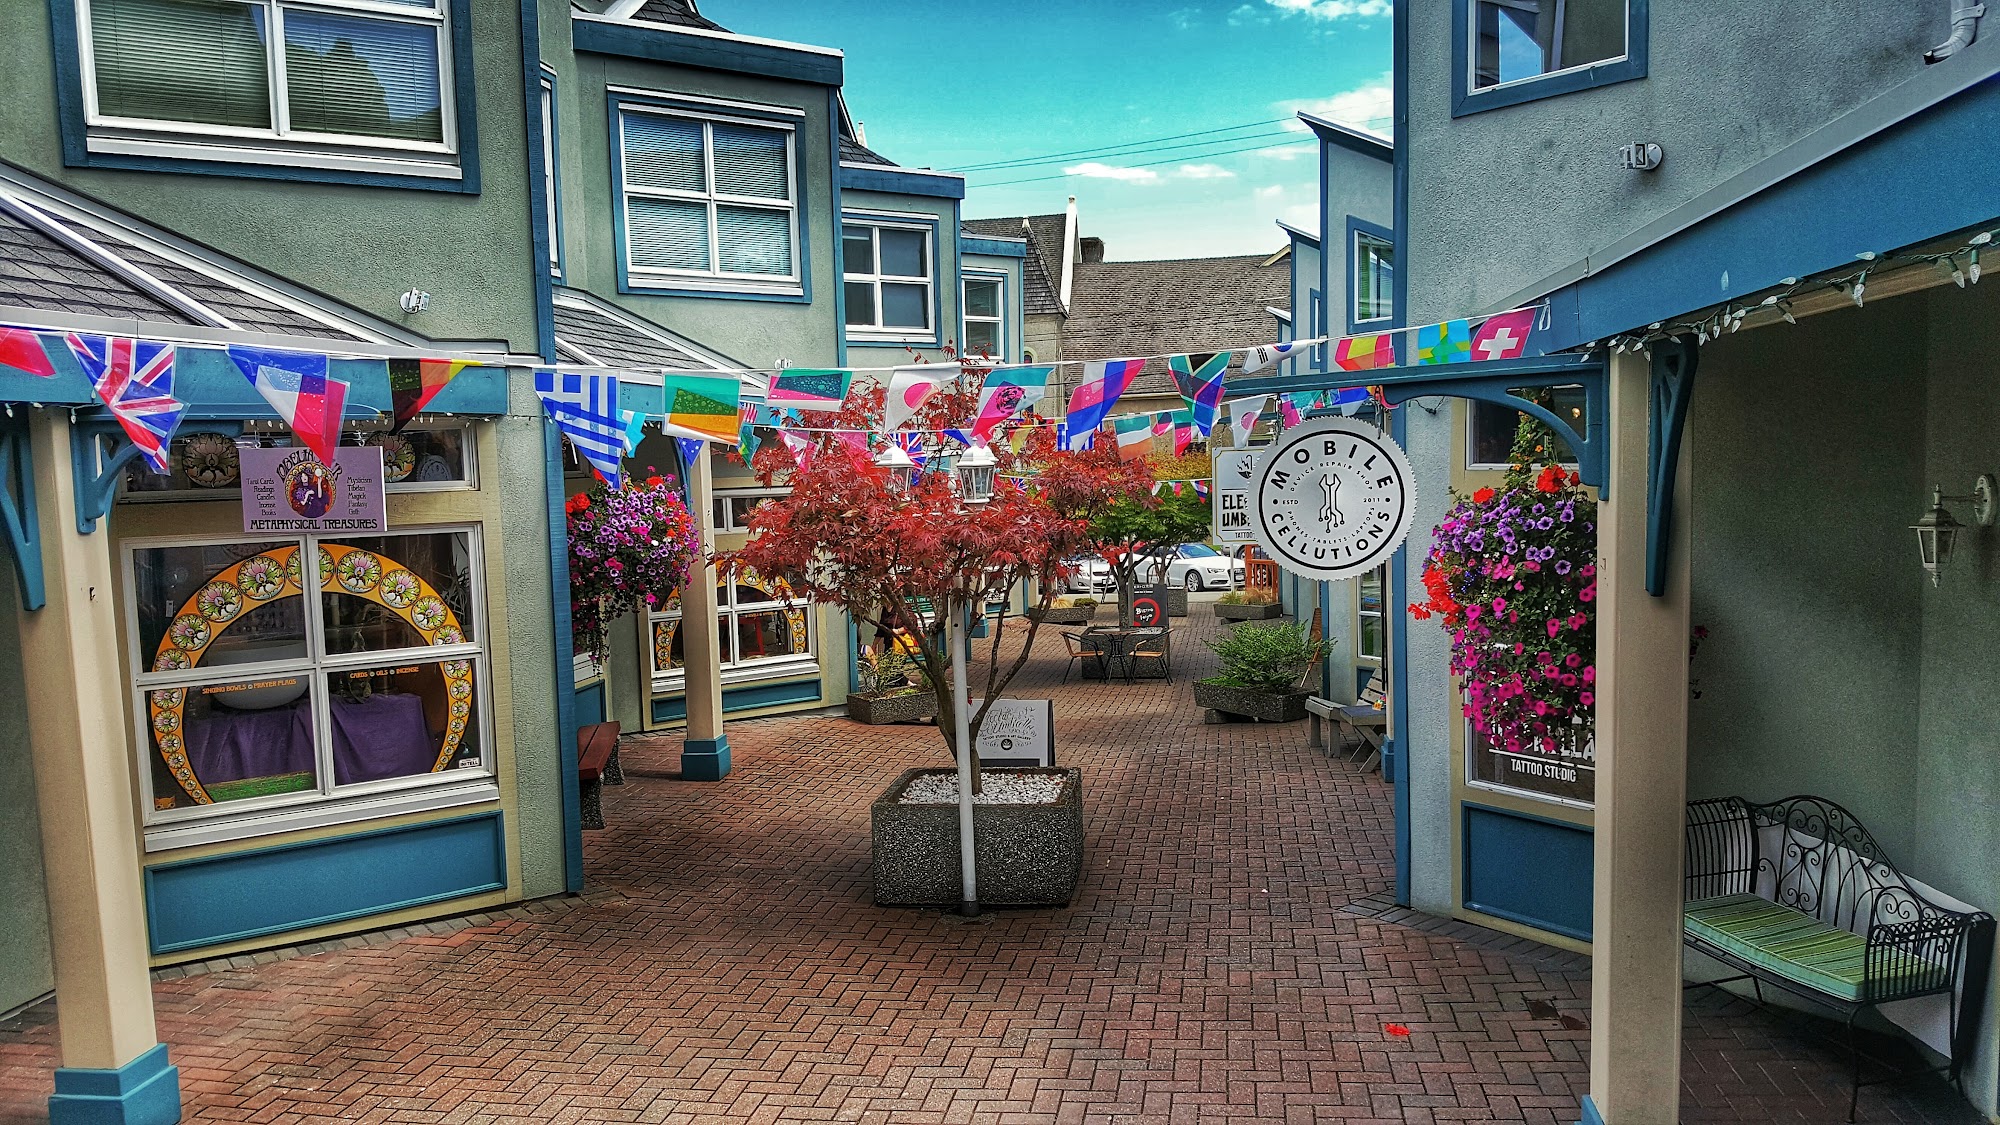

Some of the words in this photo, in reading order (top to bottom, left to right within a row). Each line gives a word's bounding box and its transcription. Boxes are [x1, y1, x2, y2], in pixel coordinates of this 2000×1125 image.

[1271, 440, 1394, 489] MOBILE
[1290, 466, 1315, 492] DEVICE
[1320, 462, 1352, 470] REPAIR
[1356, 470, 1373, 490] SHOP
[254, 486, 275, 494] Readings
[348, 492, 366, 501] Magick
[250, 519, 320, 530] METAPHYSICAL
[322, 519, 378, 530] TREASURES
[1271, 511, 1390, 560] CELLUTIONS
[349, 671, 368, 679] CARDS
[396, 666, 420, 674] INCENSE
[226, 684, 247, 692] BOWLS
[253, 681, 277, 689] PRAYER
[1511, 758, 1542, 776] TATTOO
